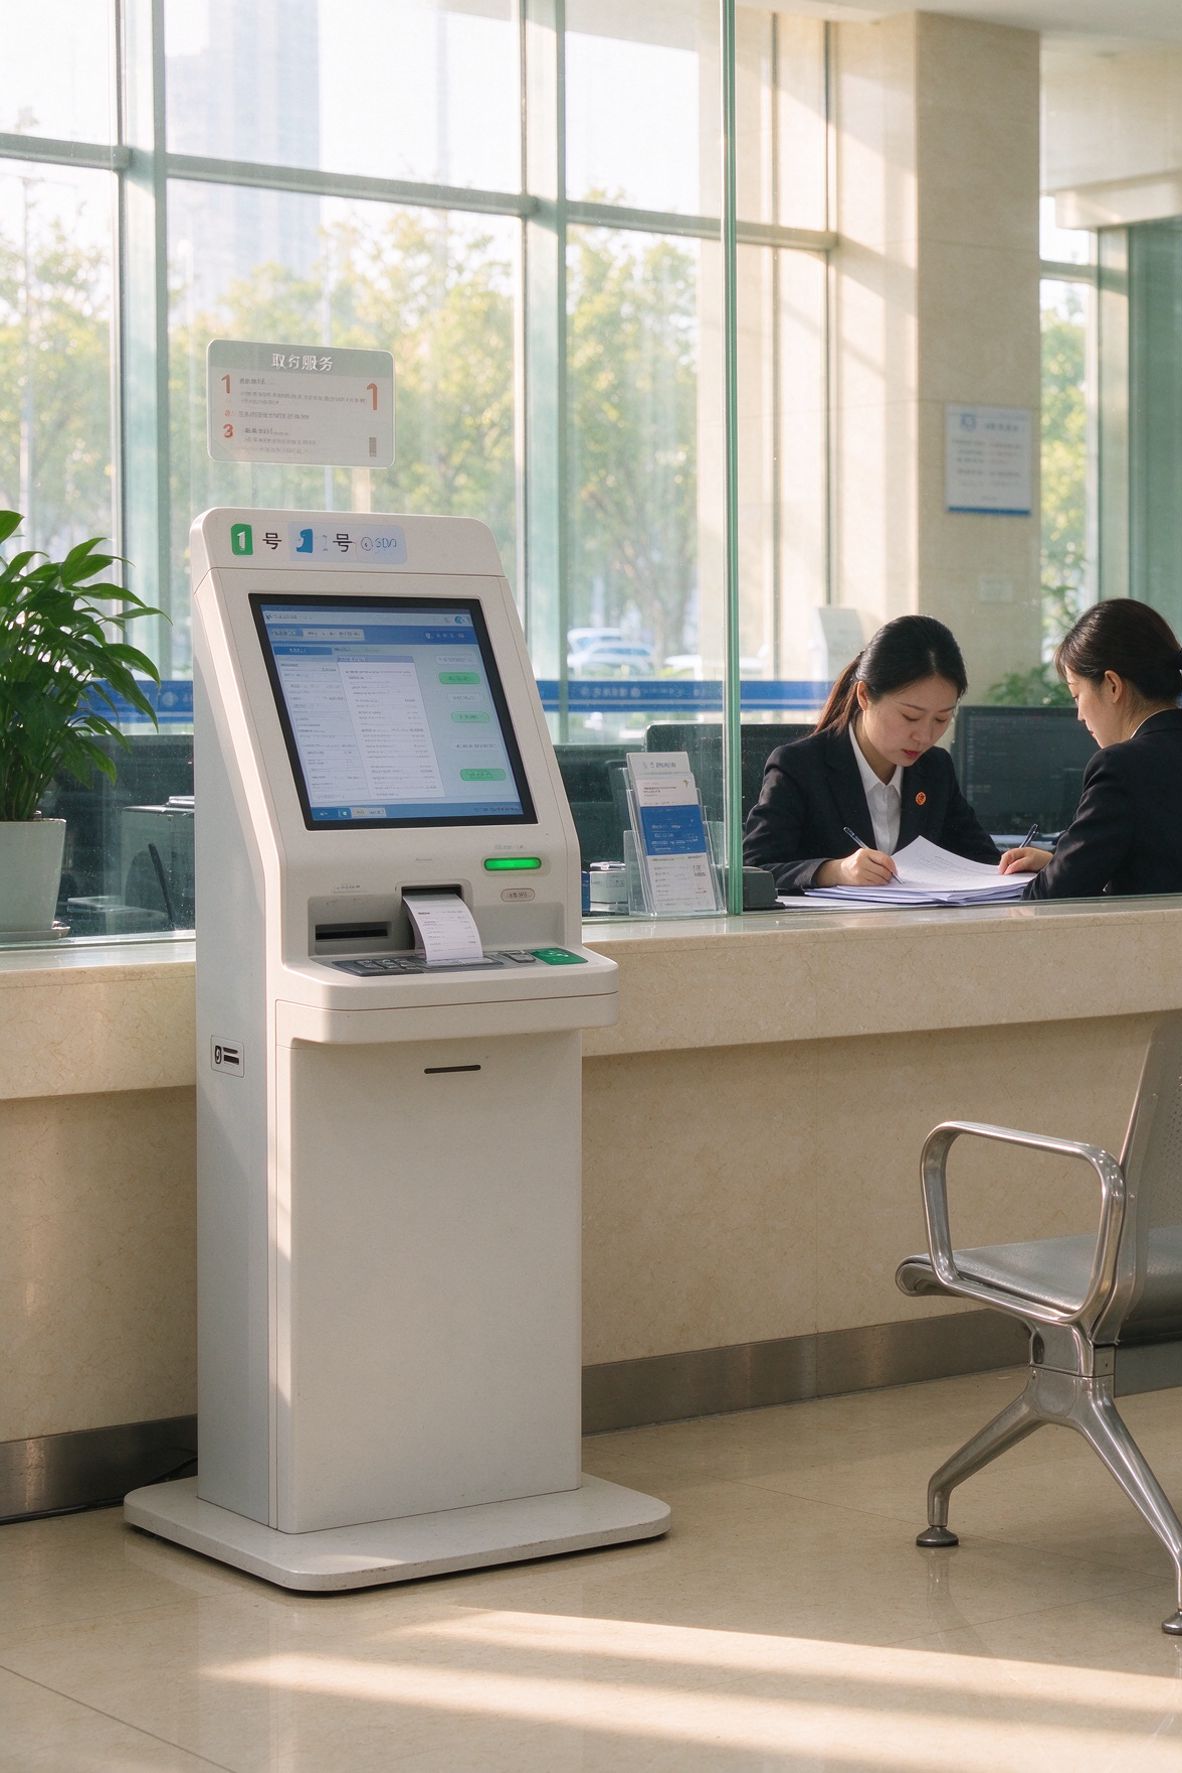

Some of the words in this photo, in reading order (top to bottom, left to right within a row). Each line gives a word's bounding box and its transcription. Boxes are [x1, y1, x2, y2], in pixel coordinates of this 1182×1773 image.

[221, 374, 231, 394] 1
[366, 382, 378, 411] 1
[223, 423, 234, 438] 3
